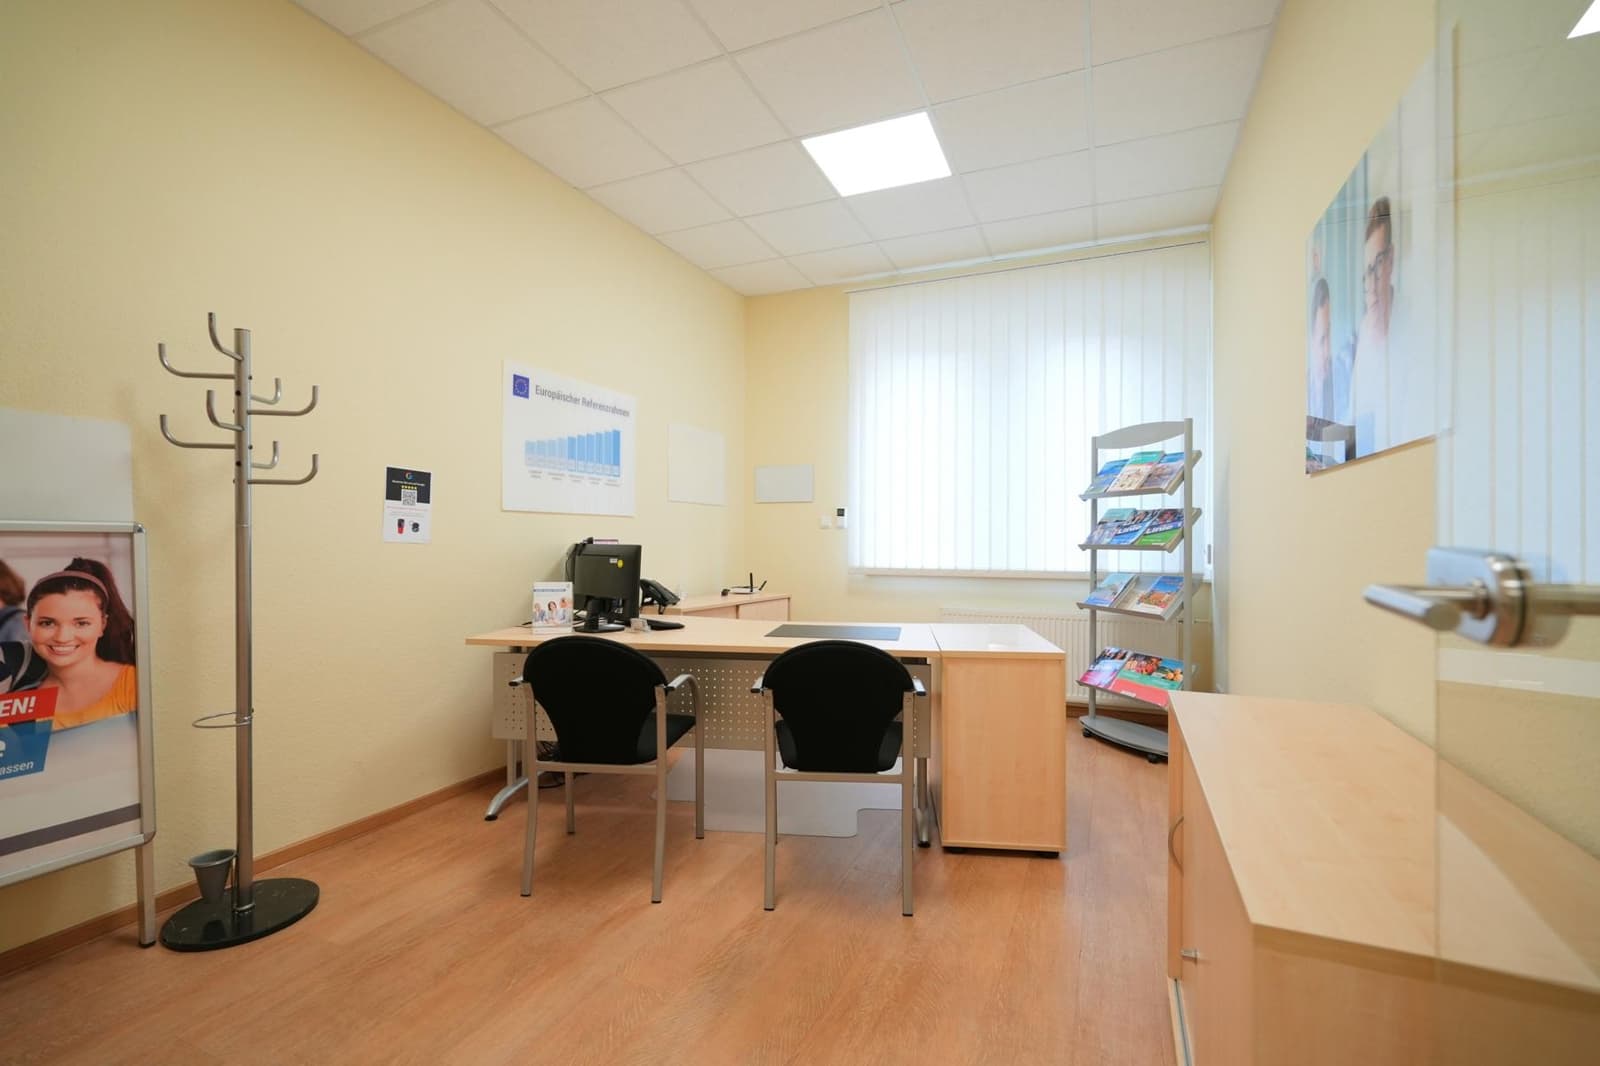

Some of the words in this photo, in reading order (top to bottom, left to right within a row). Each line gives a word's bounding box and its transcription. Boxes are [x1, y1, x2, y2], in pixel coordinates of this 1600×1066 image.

[535, 385, 580, 405] Europäischer
[581, 397, 630, 417] Referenzrahmen
[0, 696, 36, 717] EN!
